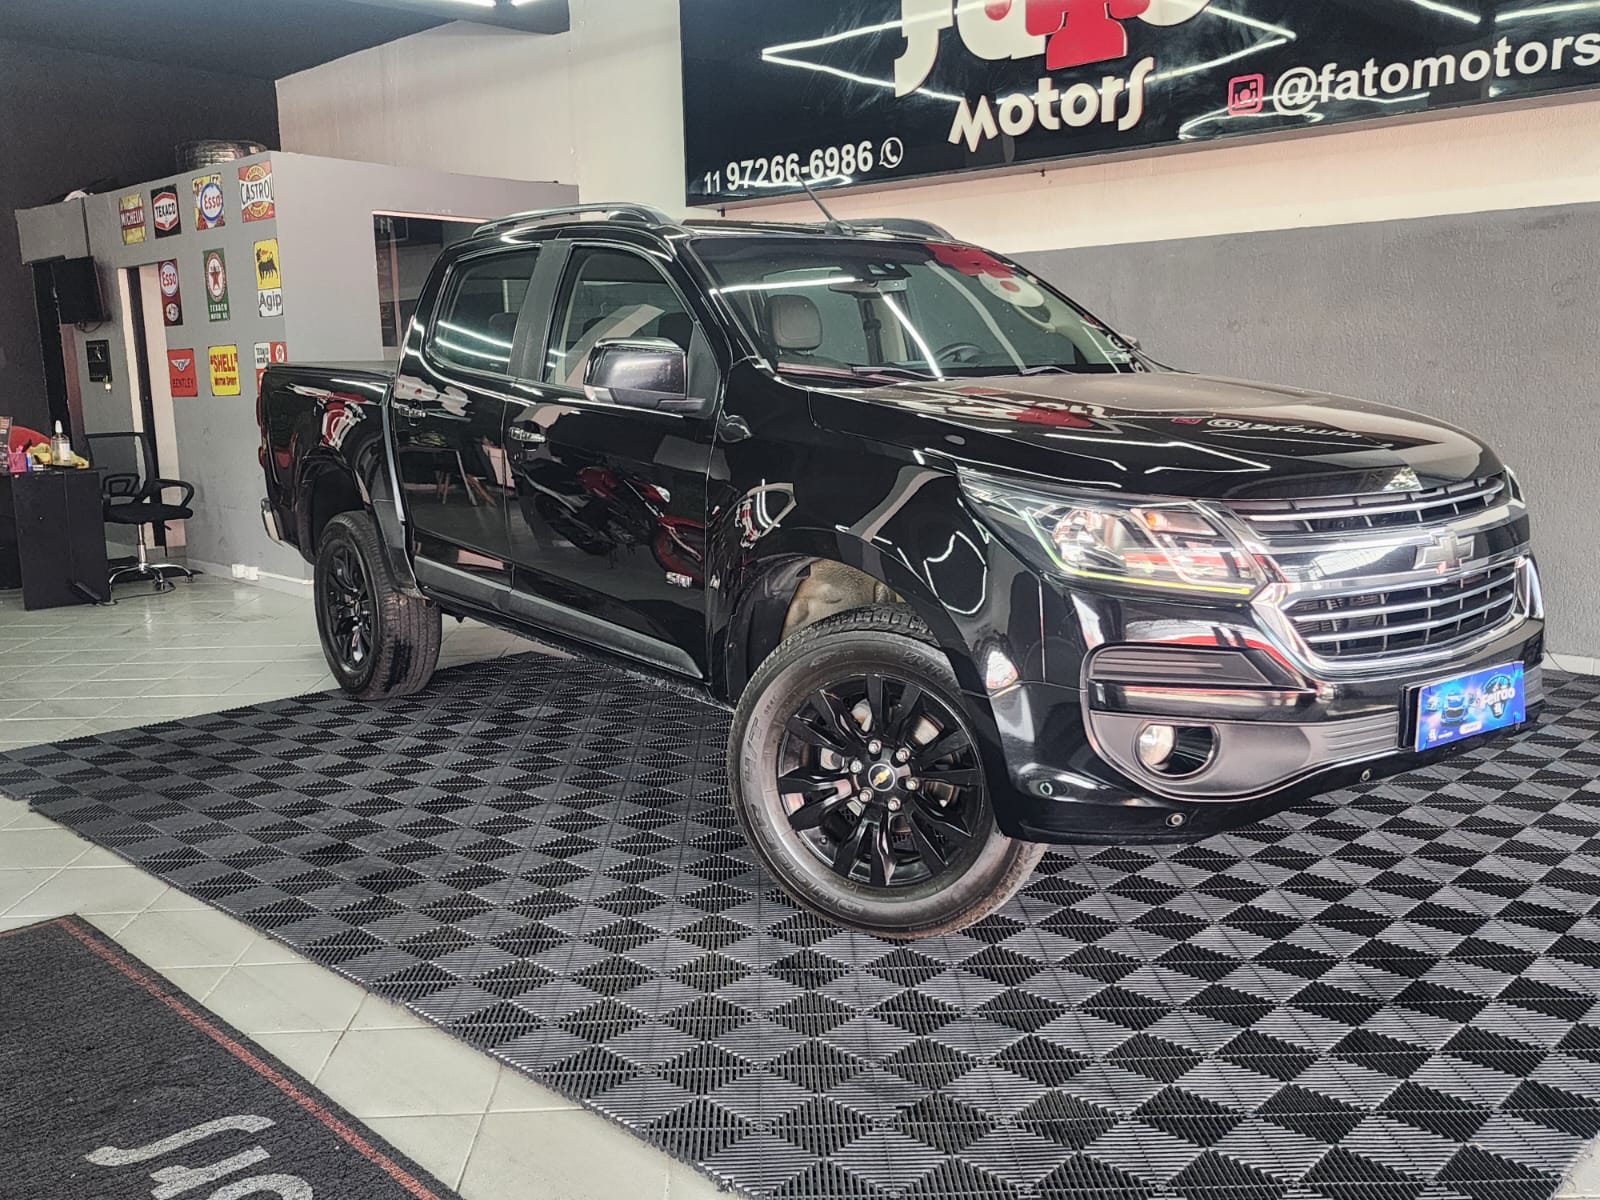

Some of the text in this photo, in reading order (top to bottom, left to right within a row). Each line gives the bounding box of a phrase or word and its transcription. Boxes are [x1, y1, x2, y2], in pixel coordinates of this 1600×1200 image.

[1273, 32, 1600, 116] @fatomotors
[948, 57, 1154, 153] Motors
[704, 140, 873, 193] 11 97266-6986
[240, 175, 274, 205] CASTROL
[155, 202, 176, 217] TEXACO
[259, 291, 282, 311] Agip
[172, 377, 194, 388] BENTLEY
